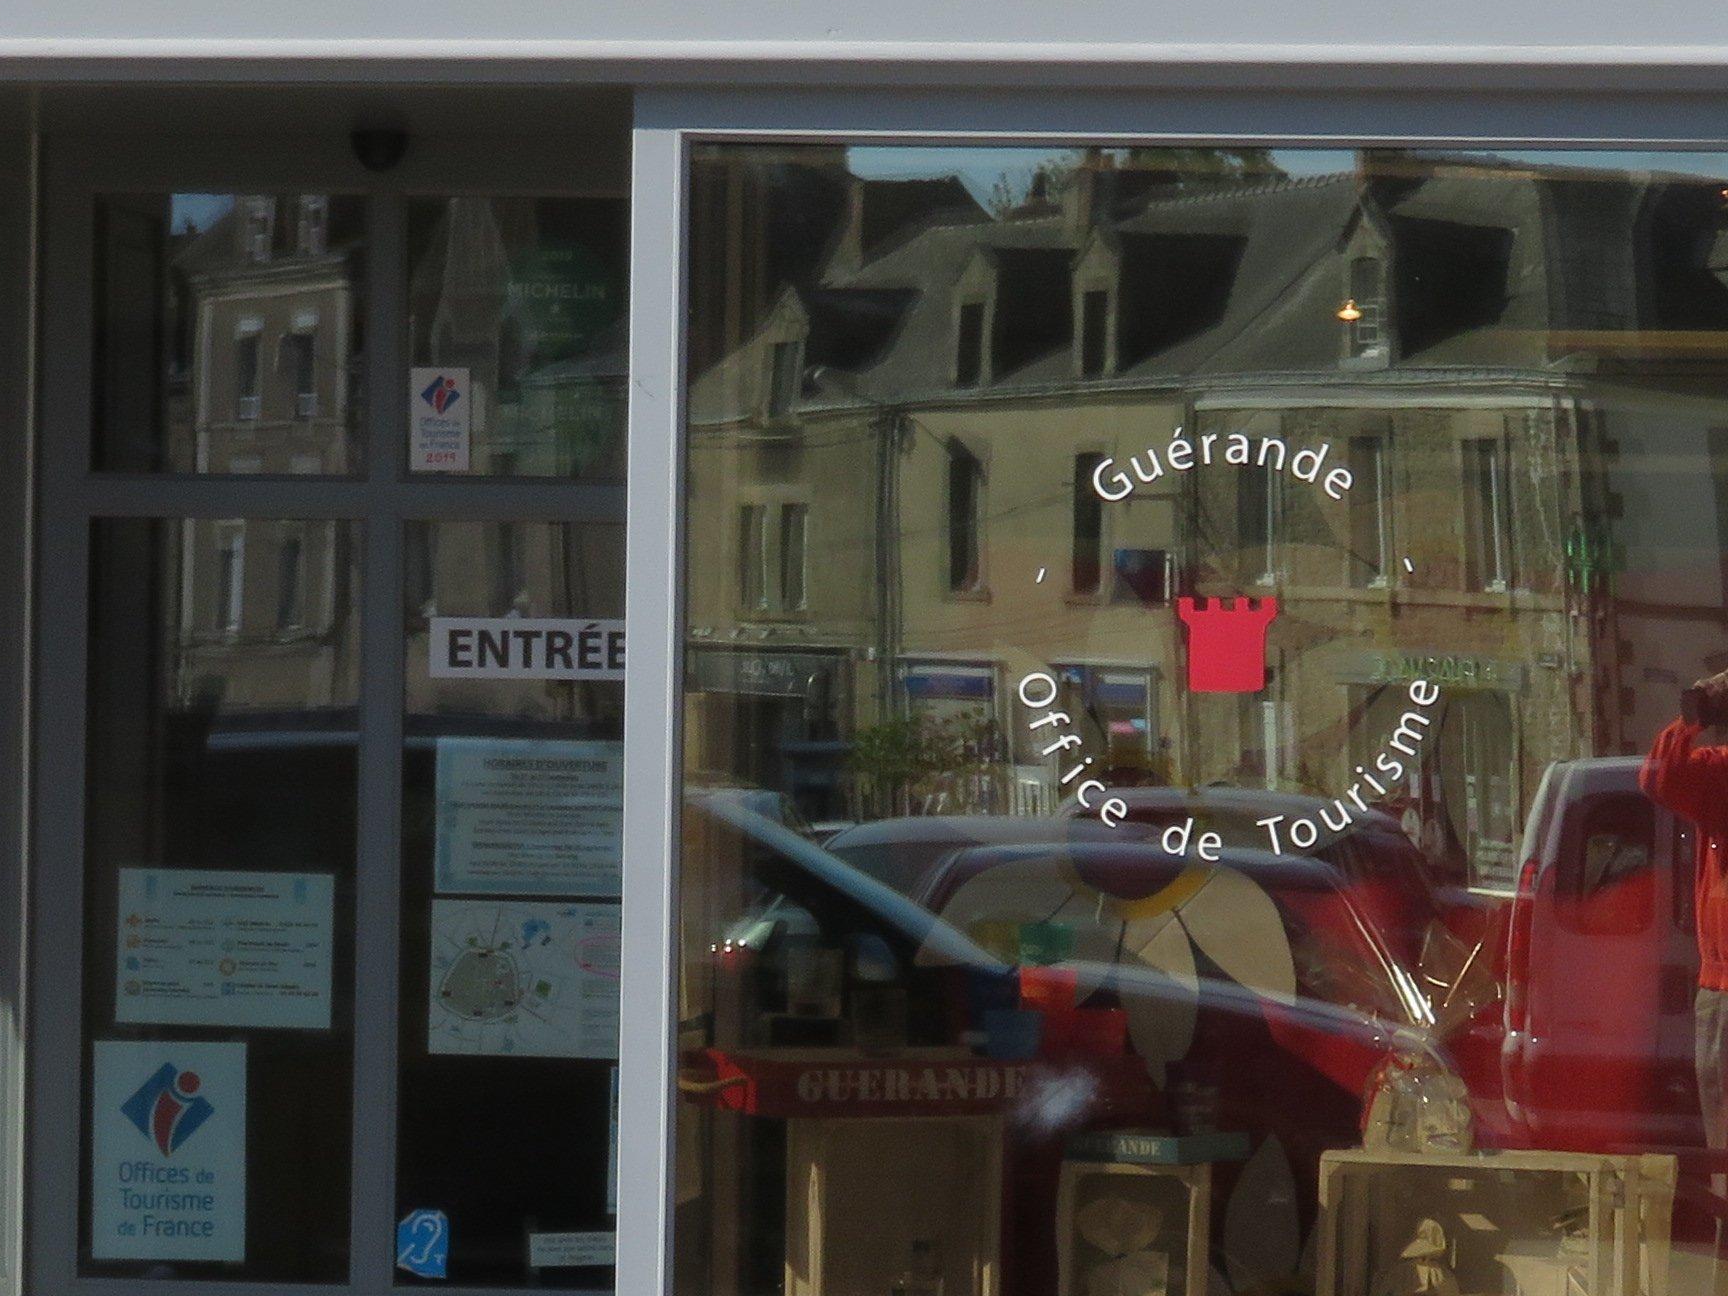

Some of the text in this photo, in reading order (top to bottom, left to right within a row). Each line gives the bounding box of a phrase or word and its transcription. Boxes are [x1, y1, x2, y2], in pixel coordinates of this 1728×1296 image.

[420, 427, 462, 438] Tourisme
[1092, 426, 1354, 503] Guérande
[448, 623, 626, 670] ENTRÉE
[1018, 672, 1440, 862] Office de Tourisme
[119, 1160, 214, 1184] Offices de
[118, 1186, 214, 1211] Tourisme
[117, 1214, 214, 1238] de France
